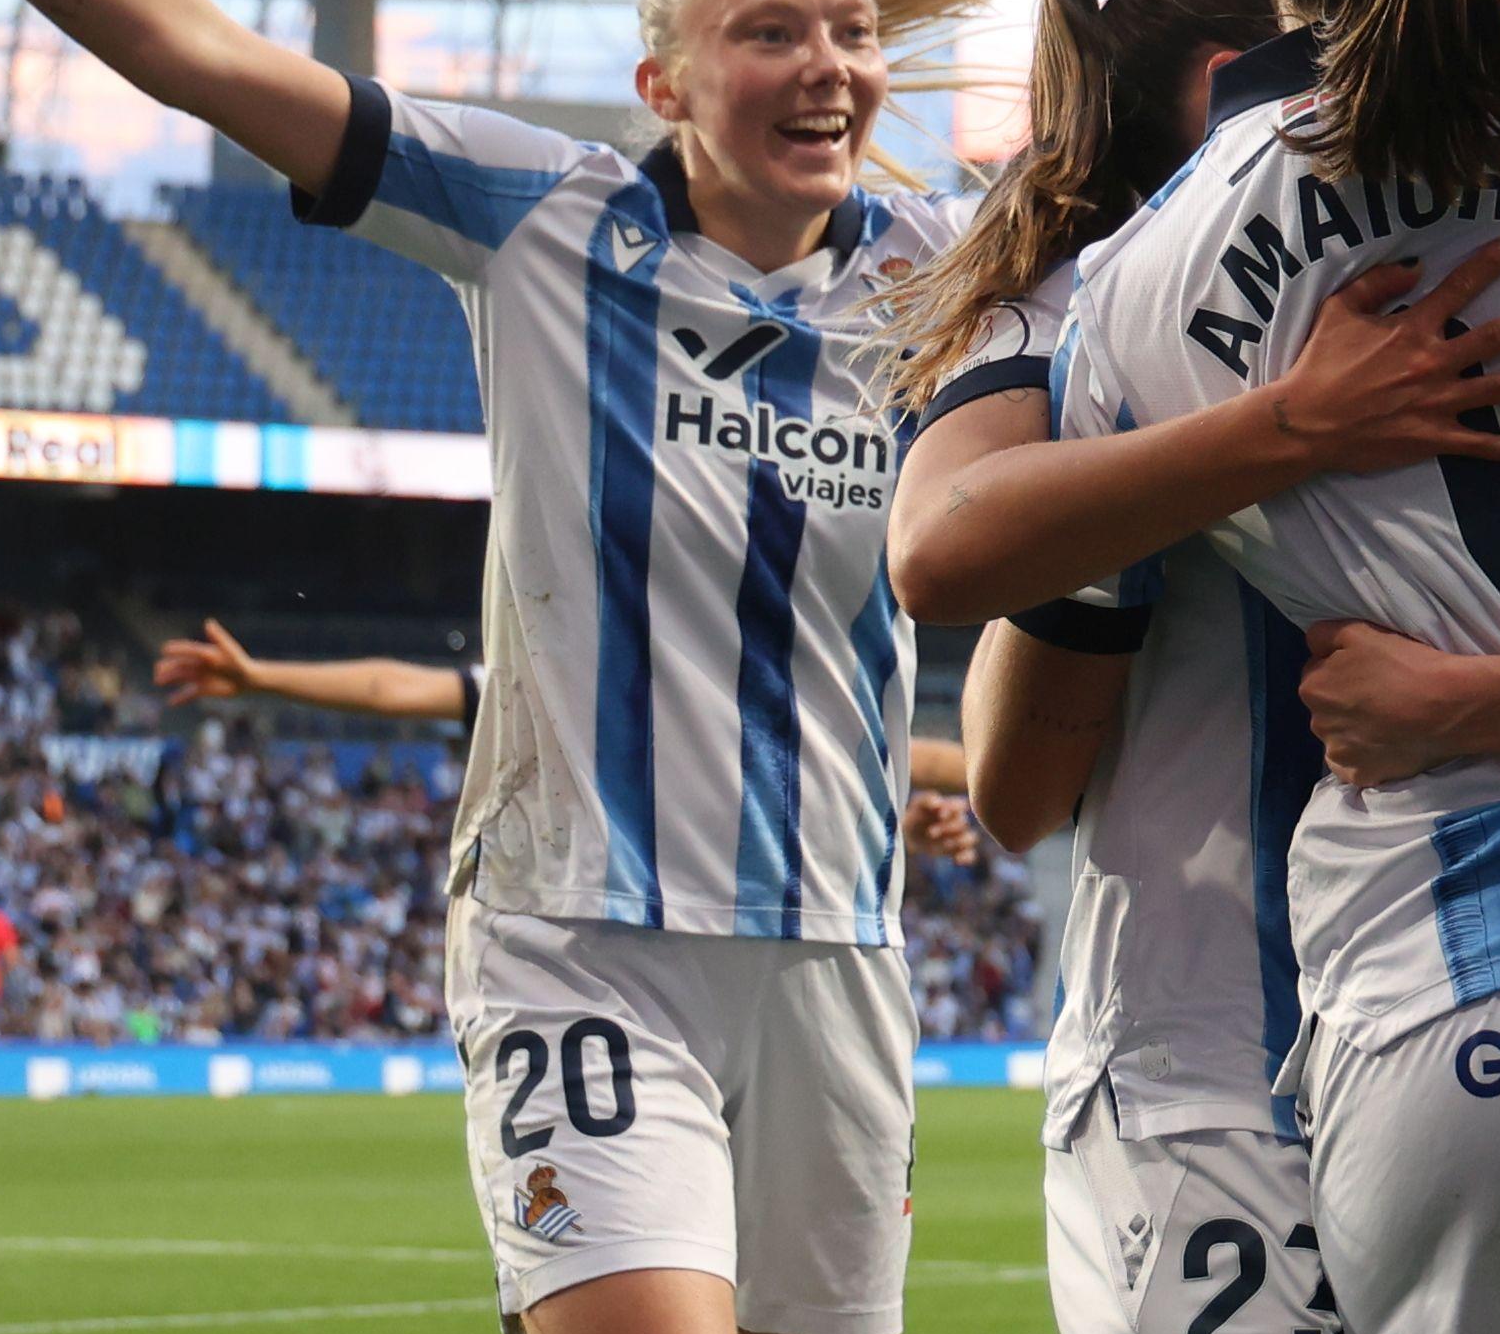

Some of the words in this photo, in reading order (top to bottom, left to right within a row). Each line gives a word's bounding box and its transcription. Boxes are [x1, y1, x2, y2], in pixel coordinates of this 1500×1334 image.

[8, 421, 117, 467] Real
[665, 393, 888, 473] Halcón
[784, 470, 883, 509] viajes
[496, 1017, 636, 1159] 20
